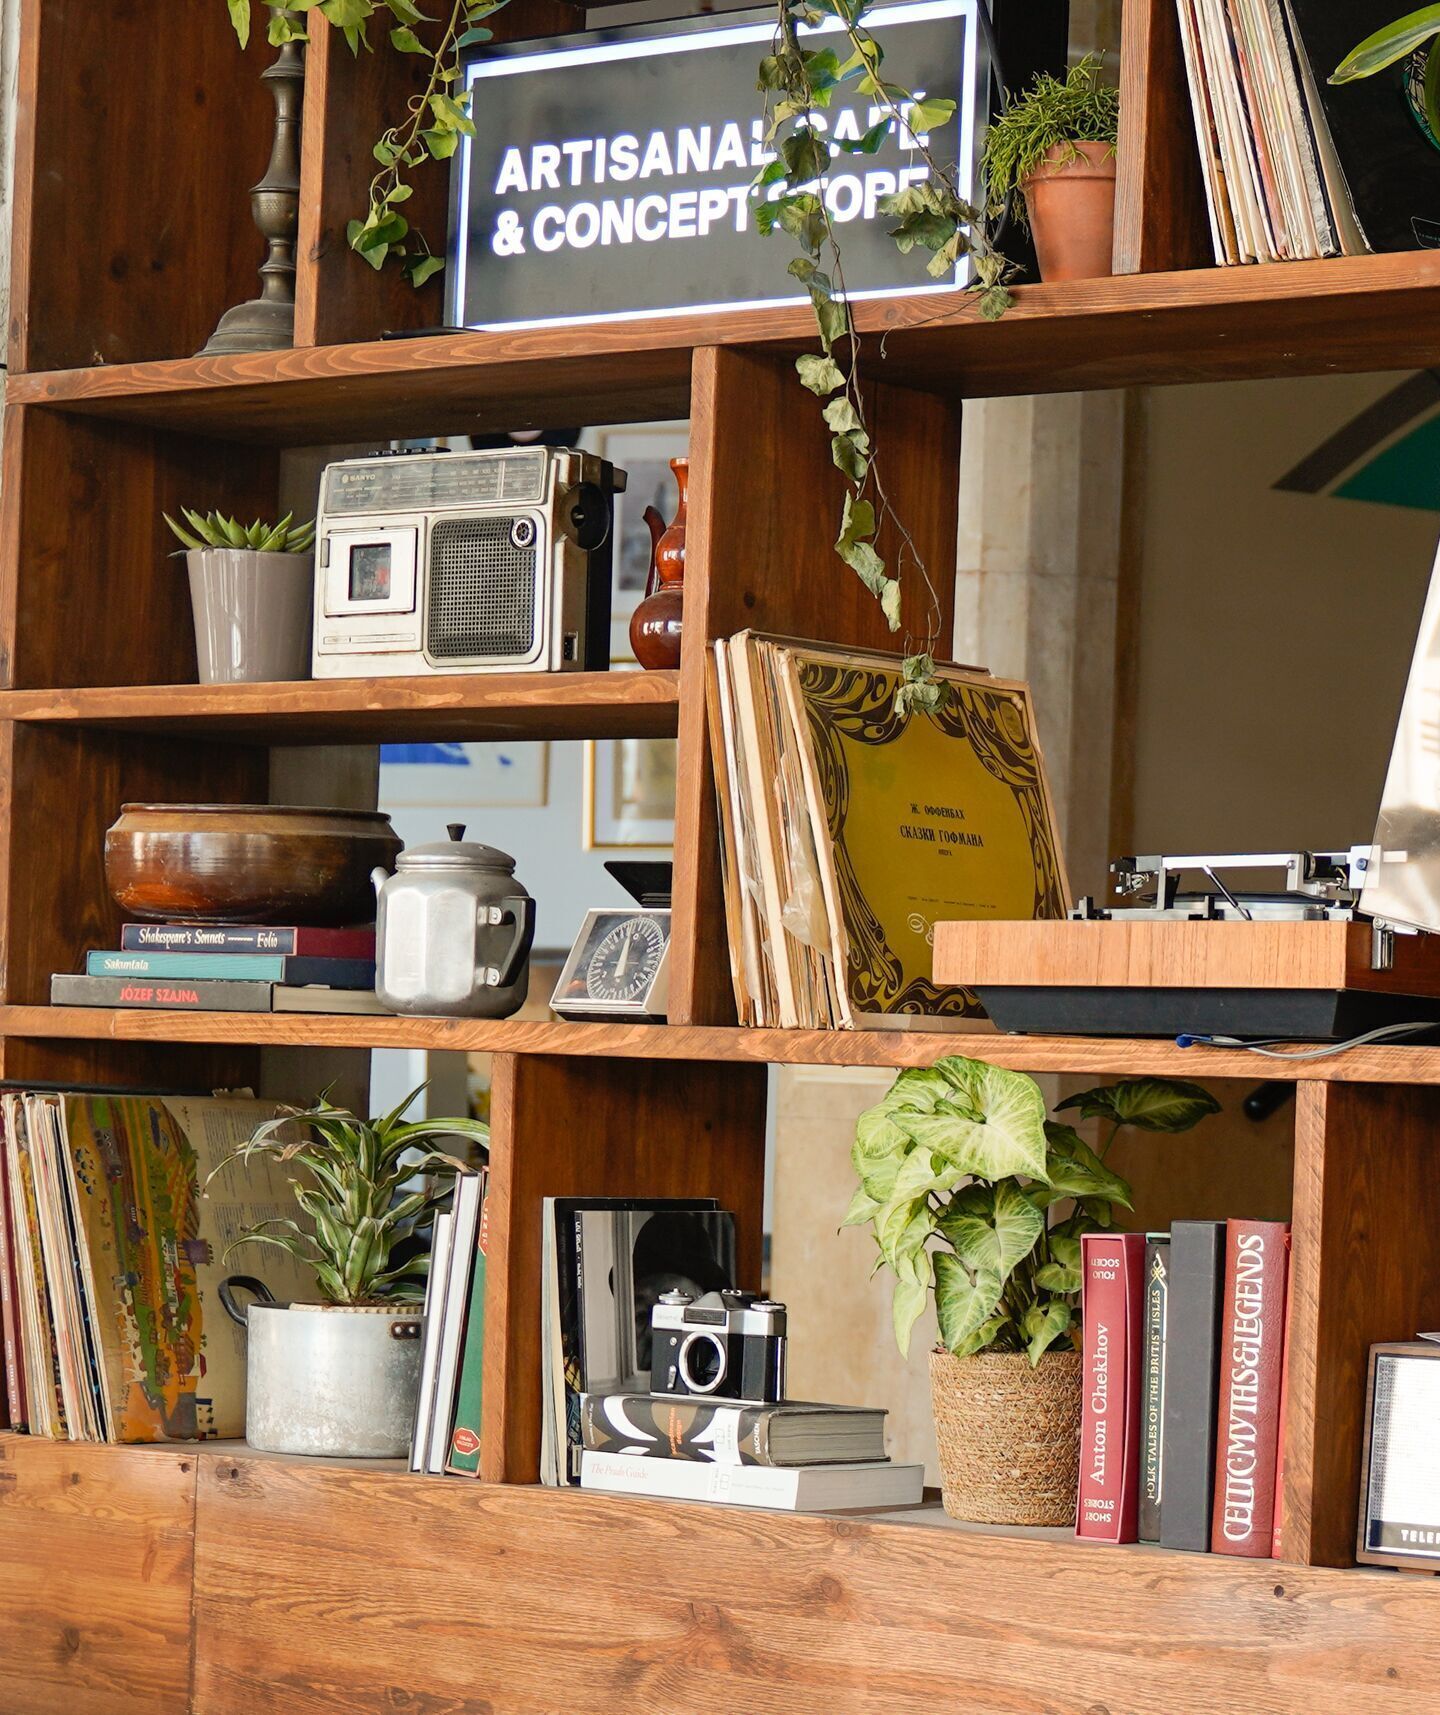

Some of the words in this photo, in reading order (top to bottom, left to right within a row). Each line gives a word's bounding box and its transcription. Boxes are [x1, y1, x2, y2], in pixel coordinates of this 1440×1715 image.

[494, 120, 778, 195] ARTISANAL
[491, 209, 526, 257] &
[532, 183, 760, 253] CONCEPT
[349, 474, 376, 482] SANYO
[924, 805, 965, 820] ОФФЕНБАХ
[900, 825, 936, 842] СКАЗКИ
[938, 829, 984, 847] ГОФМАНА
[139, 928, 192, 949] Shakespeare's
[194, 929, 226, 945] Sonnets
[257, 932, 278, 948] Folio
[104, 958, 149, 971] Sakuntala
[119, 984, 154, 1002] JÓZEF
[156, 987, 200, 1003] SZAJNA
[1234, 1234, 1265, 1347] LEGENDS
[1152, 1290, 1161, 1323] ISLES
[1091, 1323, 1109, 1415] Chekhov
[1150, 1377, 1159, 1404] THE
[1149, 1406, 1159, 1424] OF
[1090, 1419, 1107, 1486] Anton
[1148, 1426, 1158, 1464] TALES
[592, 1463, 605, 1474] The
[1085, 1512, 1112, 1523] SHORT
